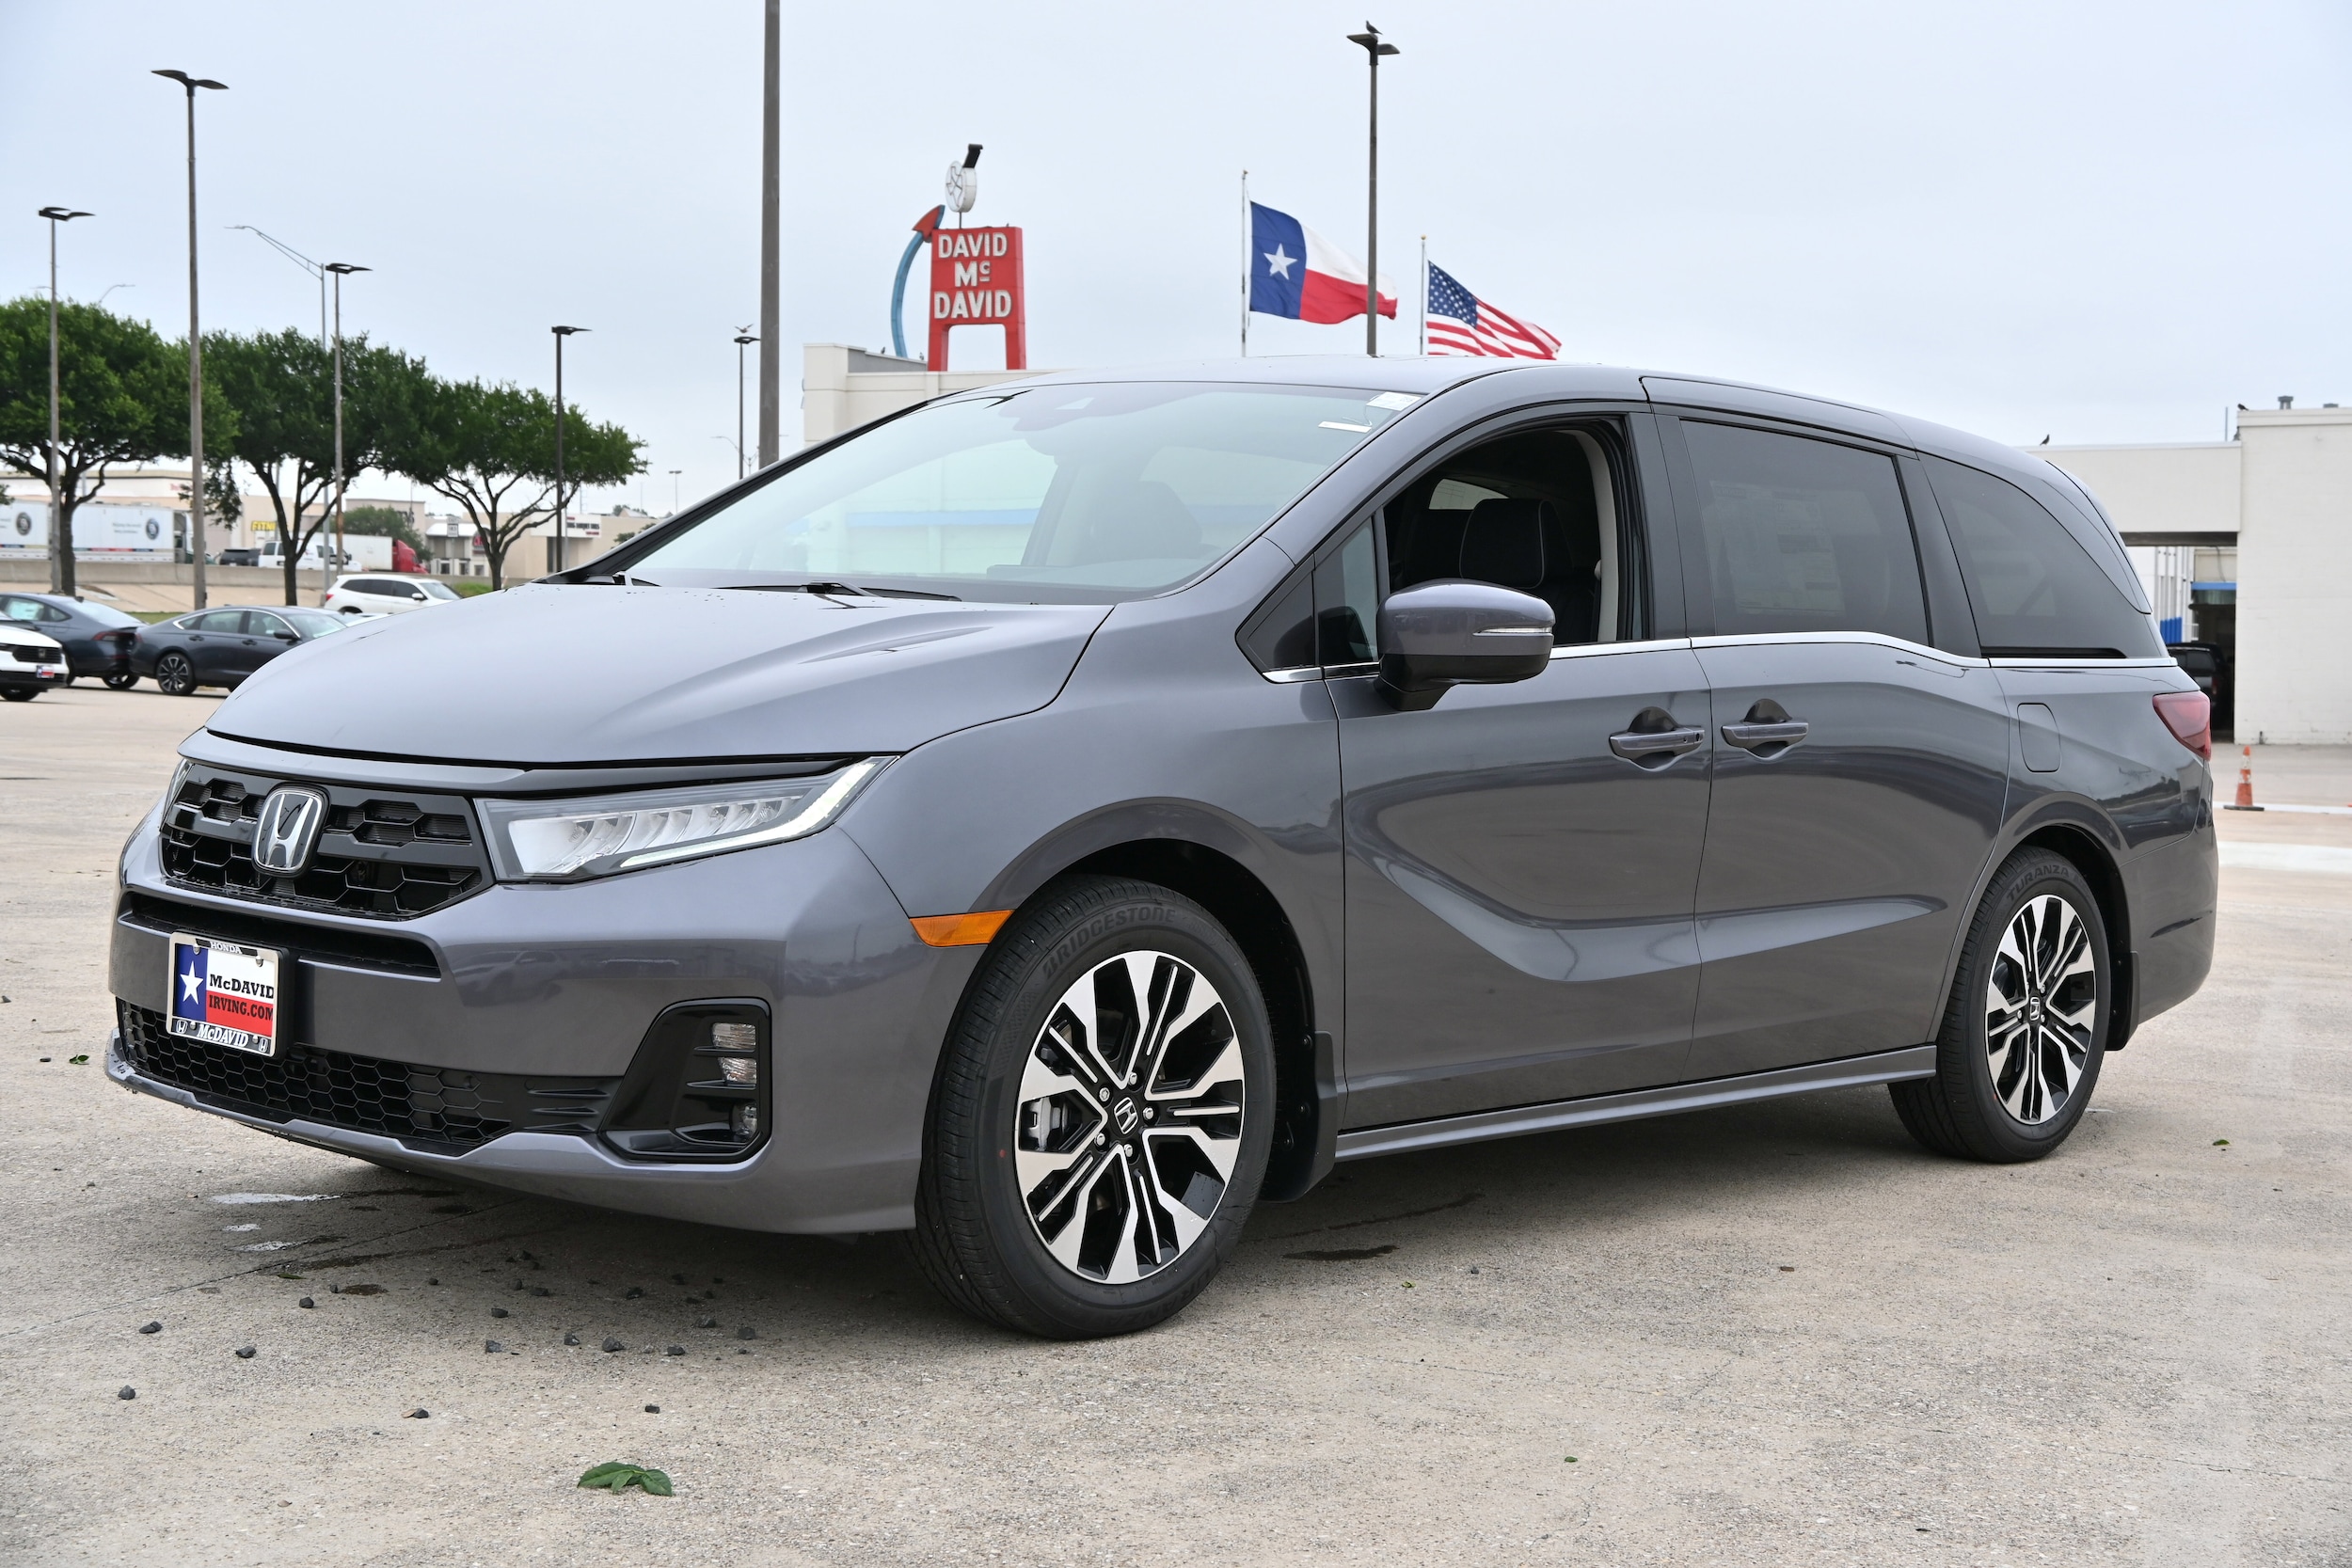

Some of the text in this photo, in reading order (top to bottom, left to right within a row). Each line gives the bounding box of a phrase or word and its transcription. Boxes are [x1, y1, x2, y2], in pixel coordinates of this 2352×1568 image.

[938, 232, 1007, 258] DAVID
[934, 290, 1011, 319] DAVID
[2006, 863, 2070, 902] TURANZA
[210, 942, 242, 954] HONDA
[1041, 906, 1176, 980] BRIDGESTONE
[210, 974, 274, 999] McDAVID
[209, 994, 274, 1021] IRVING.COM
[196, 1024, 248, 1047] McDAVID
